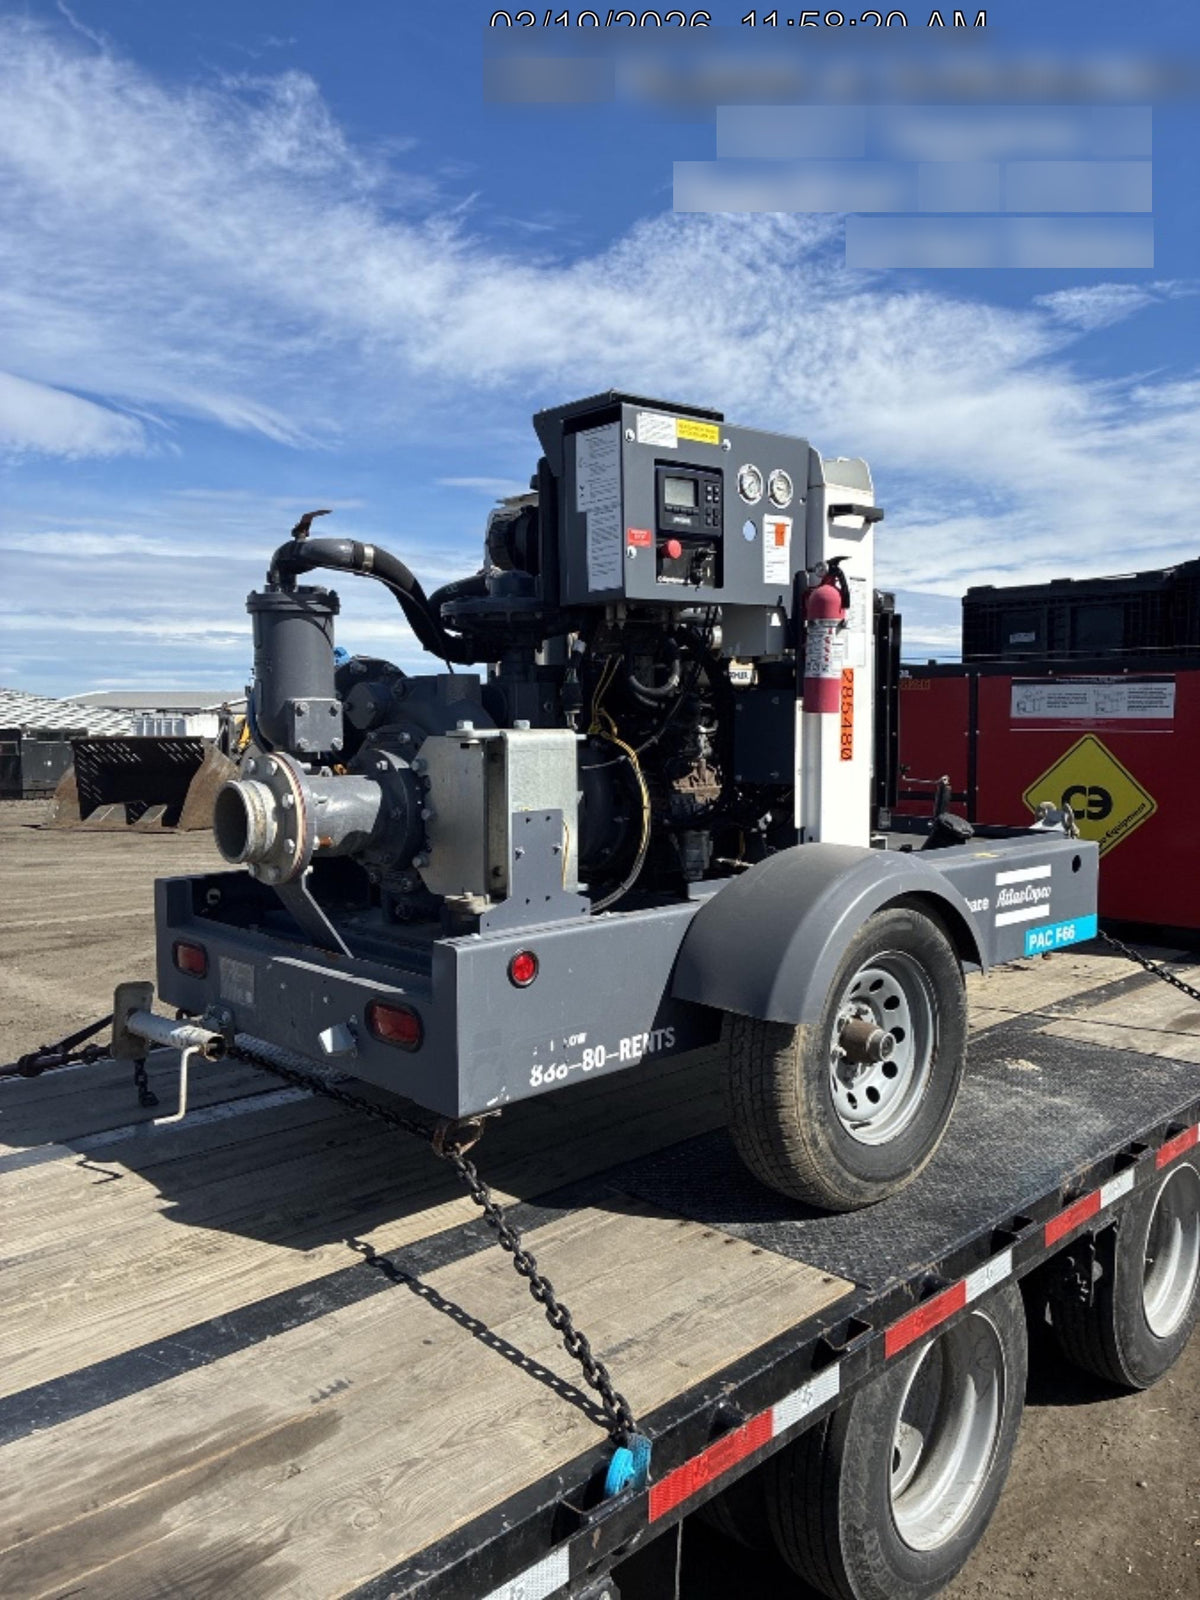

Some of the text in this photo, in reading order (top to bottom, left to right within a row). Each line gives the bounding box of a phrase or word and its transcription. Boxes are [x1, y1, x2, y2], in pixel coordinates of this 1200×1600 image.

[841, 669, 854, 760] 285480
[996, 888, 1025, 907] Atlas
[1025, 885, 1051, 904] Copco
[1029, 924, 1075, 950] PAC F66
